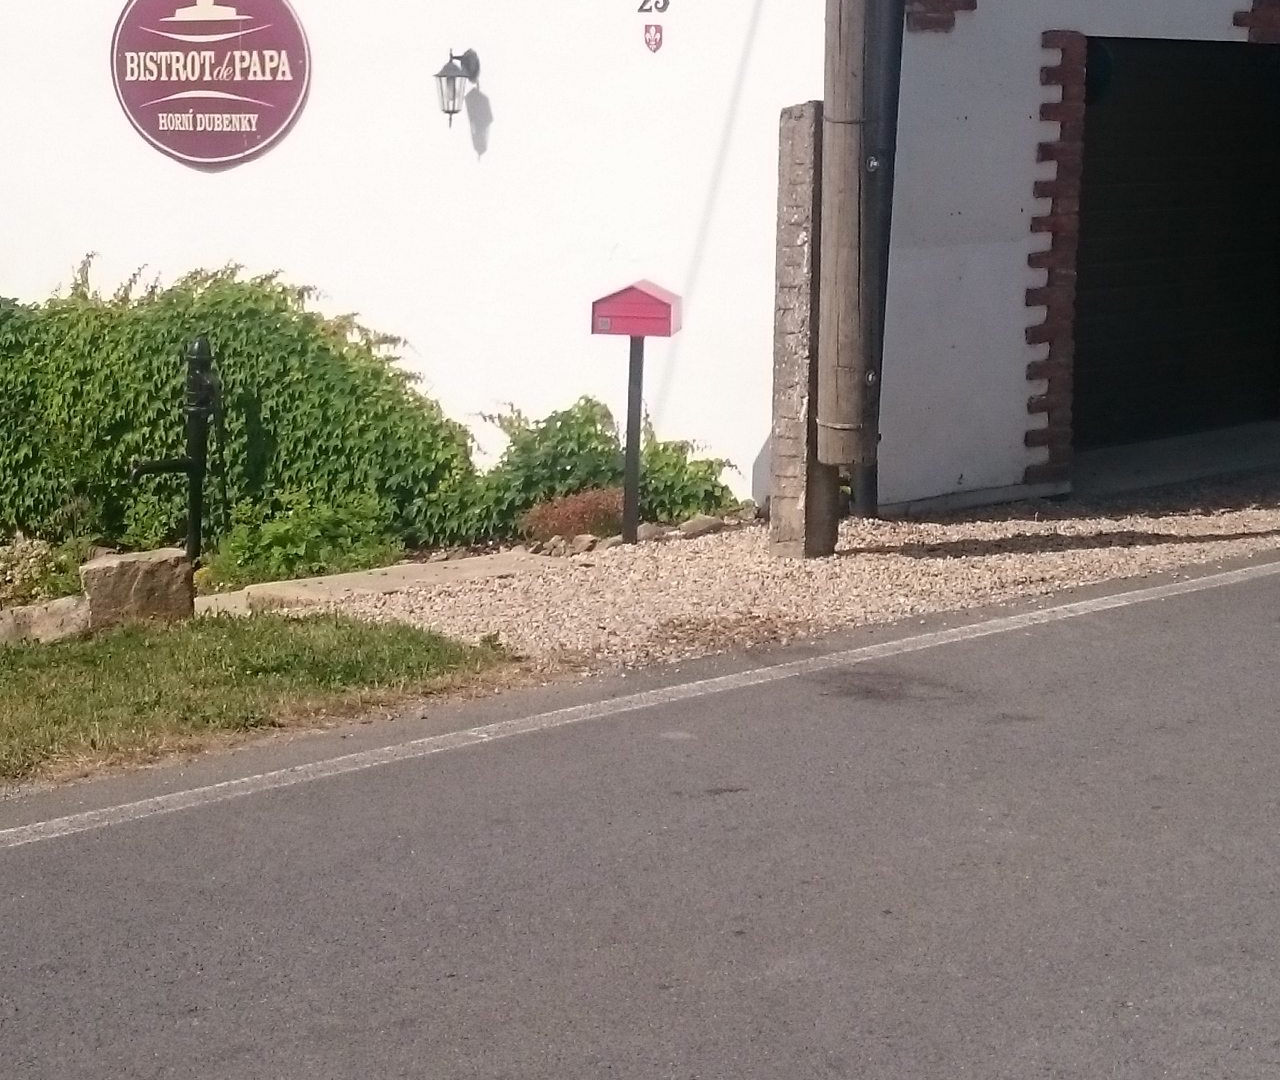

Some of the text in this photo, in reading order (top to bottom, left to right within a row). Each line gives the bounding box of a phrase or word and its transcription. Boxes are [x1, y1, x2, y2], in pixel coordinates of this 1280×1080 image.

[125, 50, 293, 81] BISTROT de PAPA
[158, 109, 259, 132] HORNÍ DUBENKY
